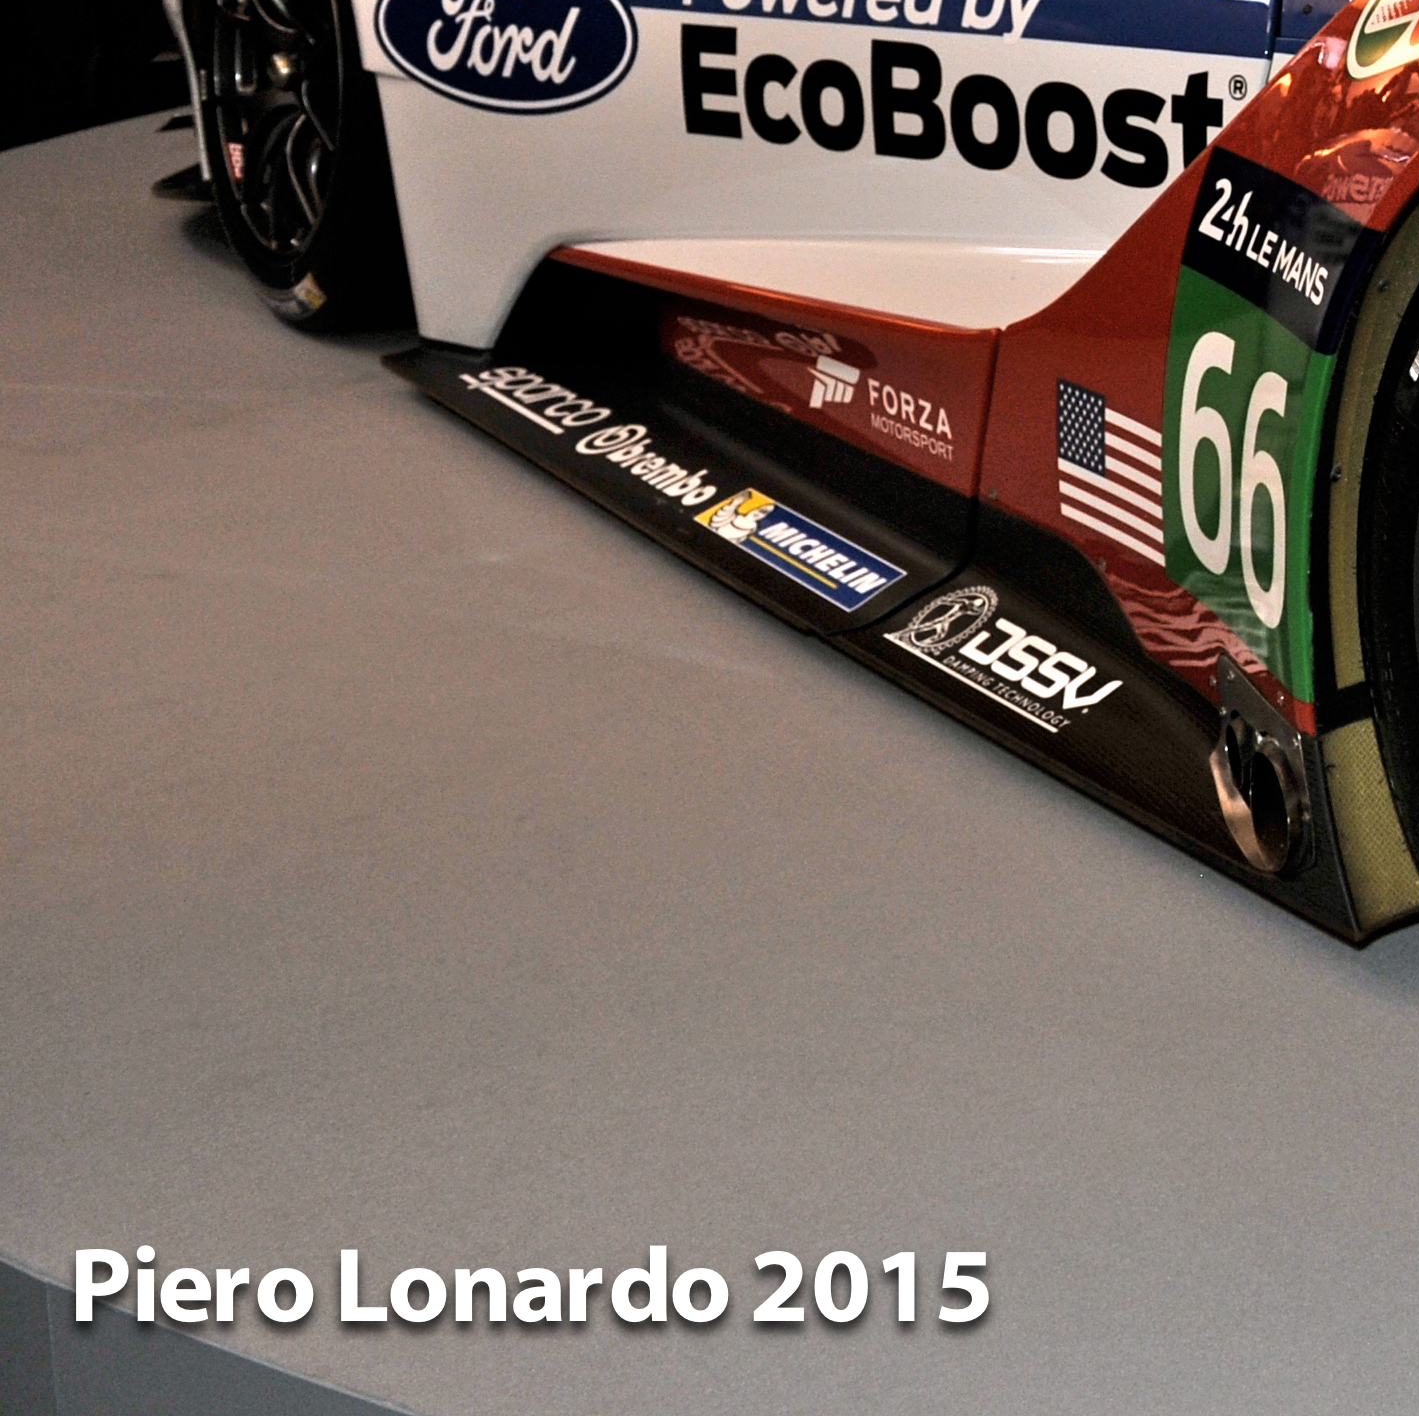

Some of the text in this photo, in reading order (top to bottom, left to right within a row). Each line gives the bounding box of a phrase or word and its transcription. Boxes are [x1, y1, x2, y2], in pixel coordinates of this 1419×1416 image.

[1245, 223, 1279, 269] LE
[1271, 239, 1329, 306] MANS
[466, 366, 612, 429] sparco
[867, 378, 953, 440] FORZA
[604, 436, 718, 506] brembo
[871, 412, 954, 461] MOTORSPORT
[1178, 331, 1289, 629] 66
[758, 521, 888, 595] MICHELIN
[942, 654, 1072, 729] DAMPING TECHNOLOGY
